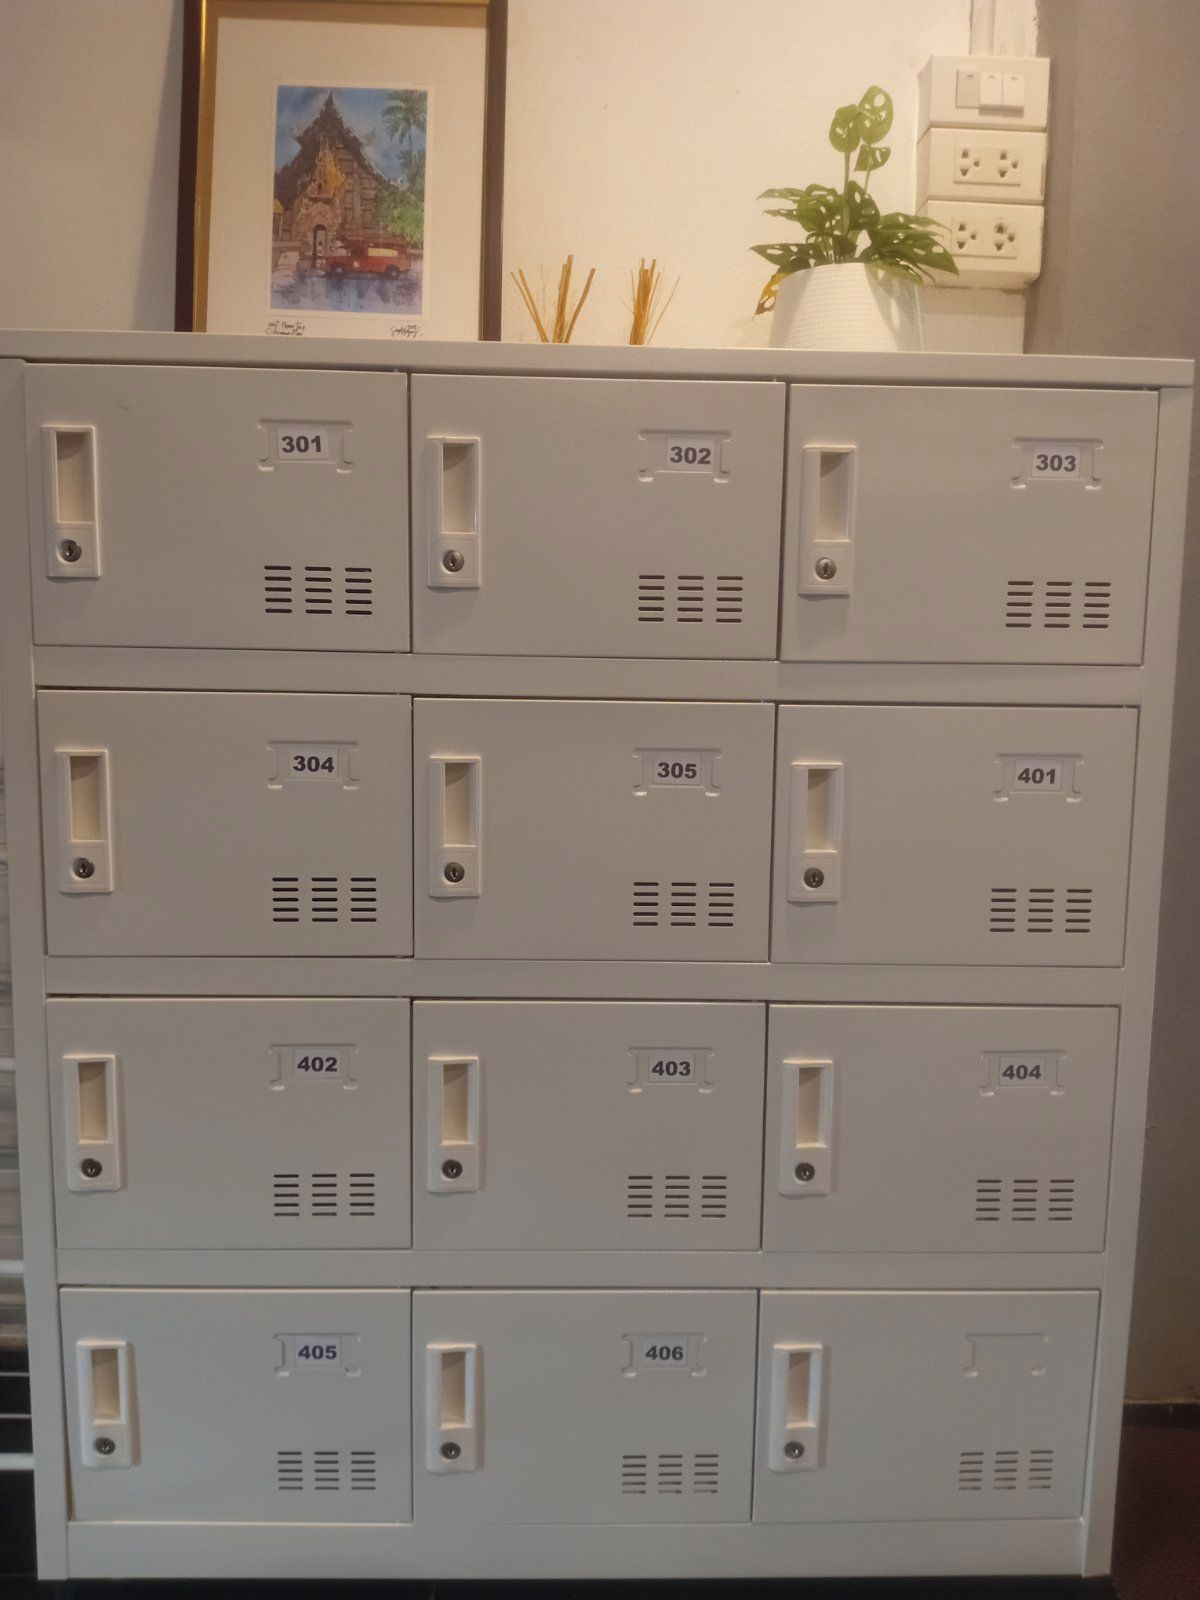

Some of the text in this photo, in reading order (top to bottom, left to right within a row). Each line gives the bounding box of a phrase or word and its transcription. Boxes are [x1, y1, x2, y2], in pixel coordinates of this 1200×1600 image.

[281, 436, 321, 452] 301
[670, 446, 711, 464] 302
[1036, 455, 1077, 471] 303
[293, 756, 335, 773] 304
[658, 762, 697, 778] 305
[1018, 769, 1056, 784] 401
[297, 1057, 338, 1072] 402
[652, 1061, 691, 1076] 403
[1003, 1065, 1042, 1080] 404
[299, 1346, 337, 1360] 405
[646, 1346, 684, 1360] 406
